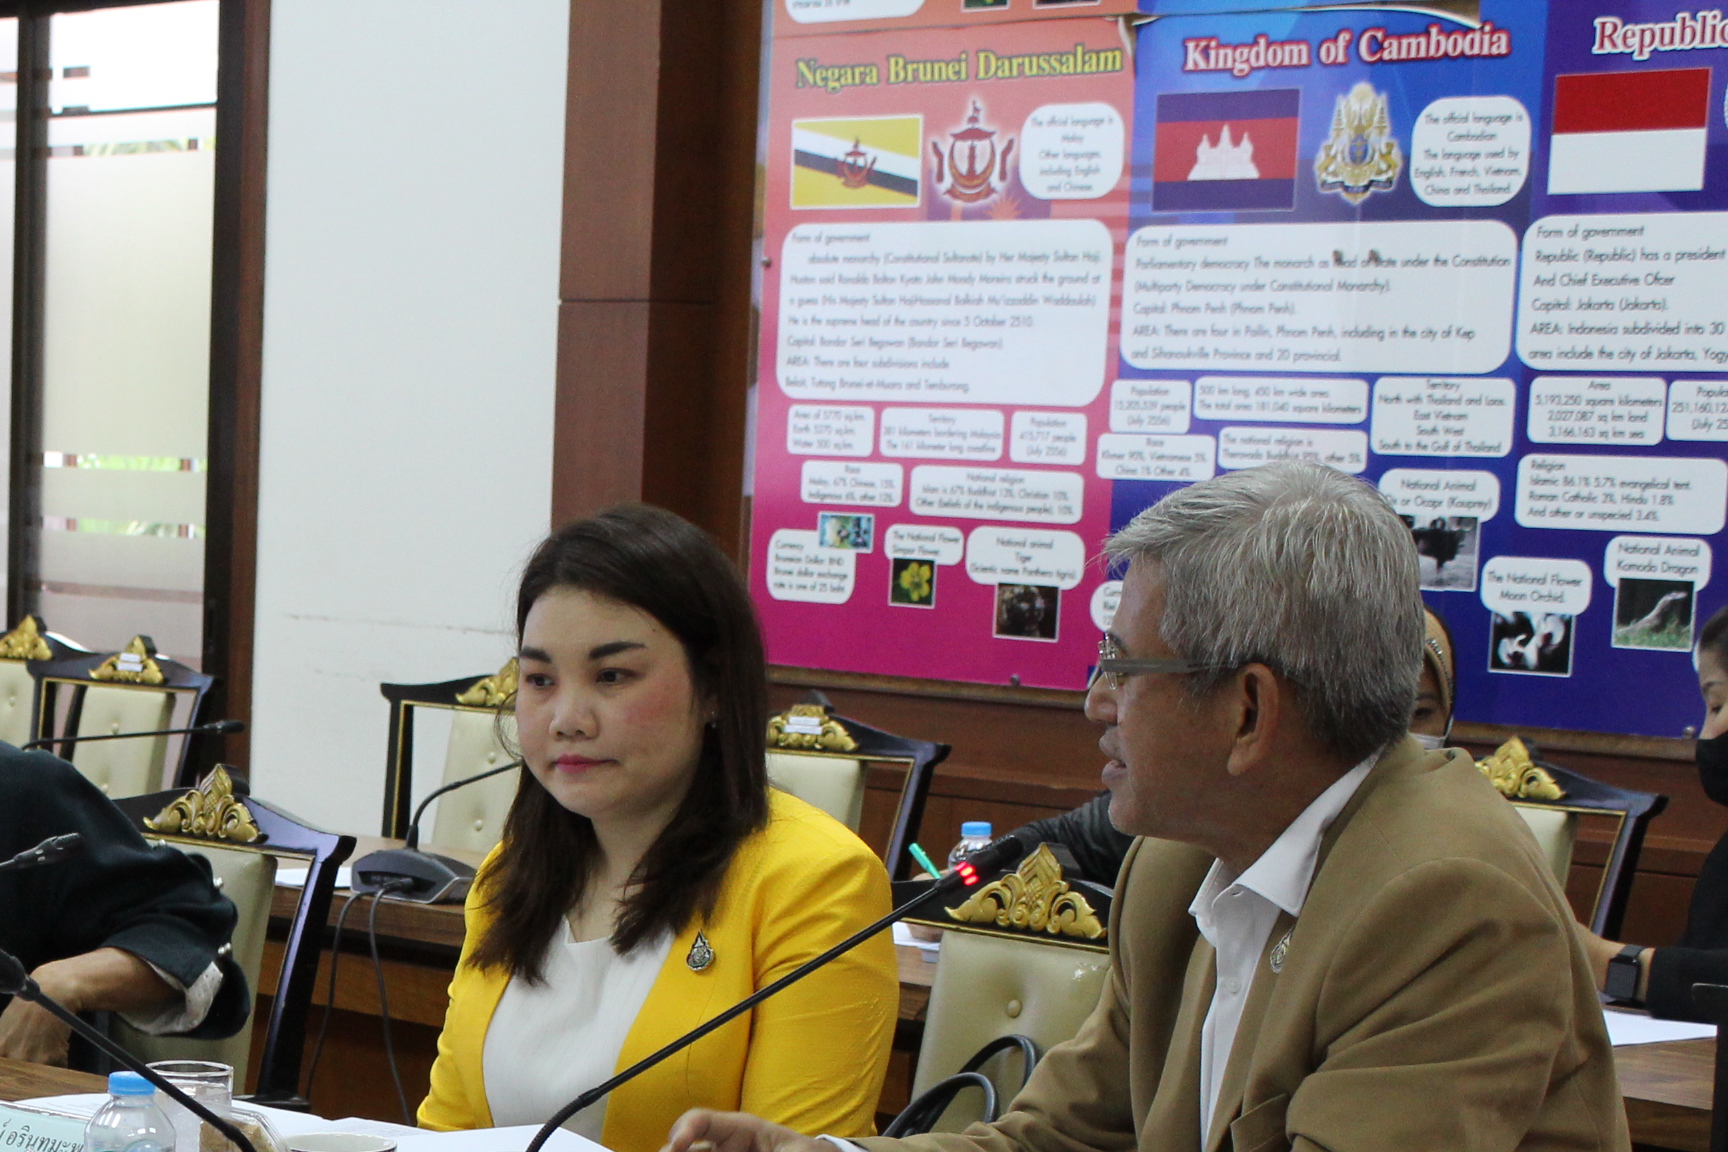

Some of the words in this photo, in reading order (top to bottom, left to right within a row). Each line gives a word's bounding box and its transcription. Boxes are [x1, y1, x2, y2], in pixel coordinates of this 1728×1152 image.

[1182, 38, 1310, 78] Kingdom
[1319, 30, 1351, 64] of
[1358, 22, 1511, 61] Cambodia
[795, 57, 880, 94] Negara
[887, 50, 968, 84] Brunei
[976, 44, 1123, 80] Darussalam
[1537, 226, 1563, 238] Form
[1567, 224, 1579, 238] of
[1582, 226, 1644, 241] government
[1137, 236, 1159, 247] Form
[1163, 234, 1173, 247] of
[1175, 237, 1228, 249] government
[1136, 258, 1197, 271] Parliamentary
[1200, 258, 1250, 271] democracy
[1254, 256, 1270, 268] The
[1273, 256, 1314, 269] monarch
[1318, 260, 1330, 268] as
[1401, 254, 1429, 267] under
[1433, 255, 1448, 267] the
[1452, 255, 1511, 267] Constitution
[1536, 249, 1579, 264] Republic
[1583, 248, 1636, 264] (Republic)
[1640, 247, 1659, 261] has
[1663, 252, 1671, 261] a
[1675, 247, 1726, 263] president
[1185, 280, 1236, 294] Democracy
[1240, 279, 1266, 292] under
[1270, 279, 1333, 292] Constitutional
[1533, 274, 1555, 287] And
[1559, 273, 1588, 286] Chief
[1591, 274, 1640, 286] Executive
[1576, 297, 1615, 310] Jakarta
[1568, 322, 1618, 335] Indonesia
[1623, 321, 1680, 335] subdivided
[1685, 324, 1705, 335] into
[1710, 322, 1725, 335] 30
[1528, 351, 1552, 359] area
[1557, 346, 1593, 359] include
[1598, 346, 1613, 359] the
[1617, 348, 1637, 363] city
[1640, 346, 1652, 360] of
[1588, 381, 1611, 390] Area
[1585, 399, 1615, 408] square
[1618, 395, 1663, 407] kilometers
[1531, 460, 1565, 473] Religion
[1401, 480, 1440, 491] National
[1443, 480, 1476, 491] Animal
[1529, 491, 1558, 501] Roman
[1562, 492, 1597, 503] Catholic
[1621, 494, 1648, 505] Hindu
[1527, 507, 1545, 517] And
[1550, 508, 1572, 518] other
[1619, 543, 1660, 555] National
[1664, 545, 1700, 557] Animal
[1617, 560, 1658, 572] Komodo
[1661, 561, 1698, 577] Dragon
[1488, 571, 1503, 583] The
[1507, 573, 1547, 585] National
[1551, 574, 1582, 587] Flower
[1501, 591, 1527, 600] Moon
